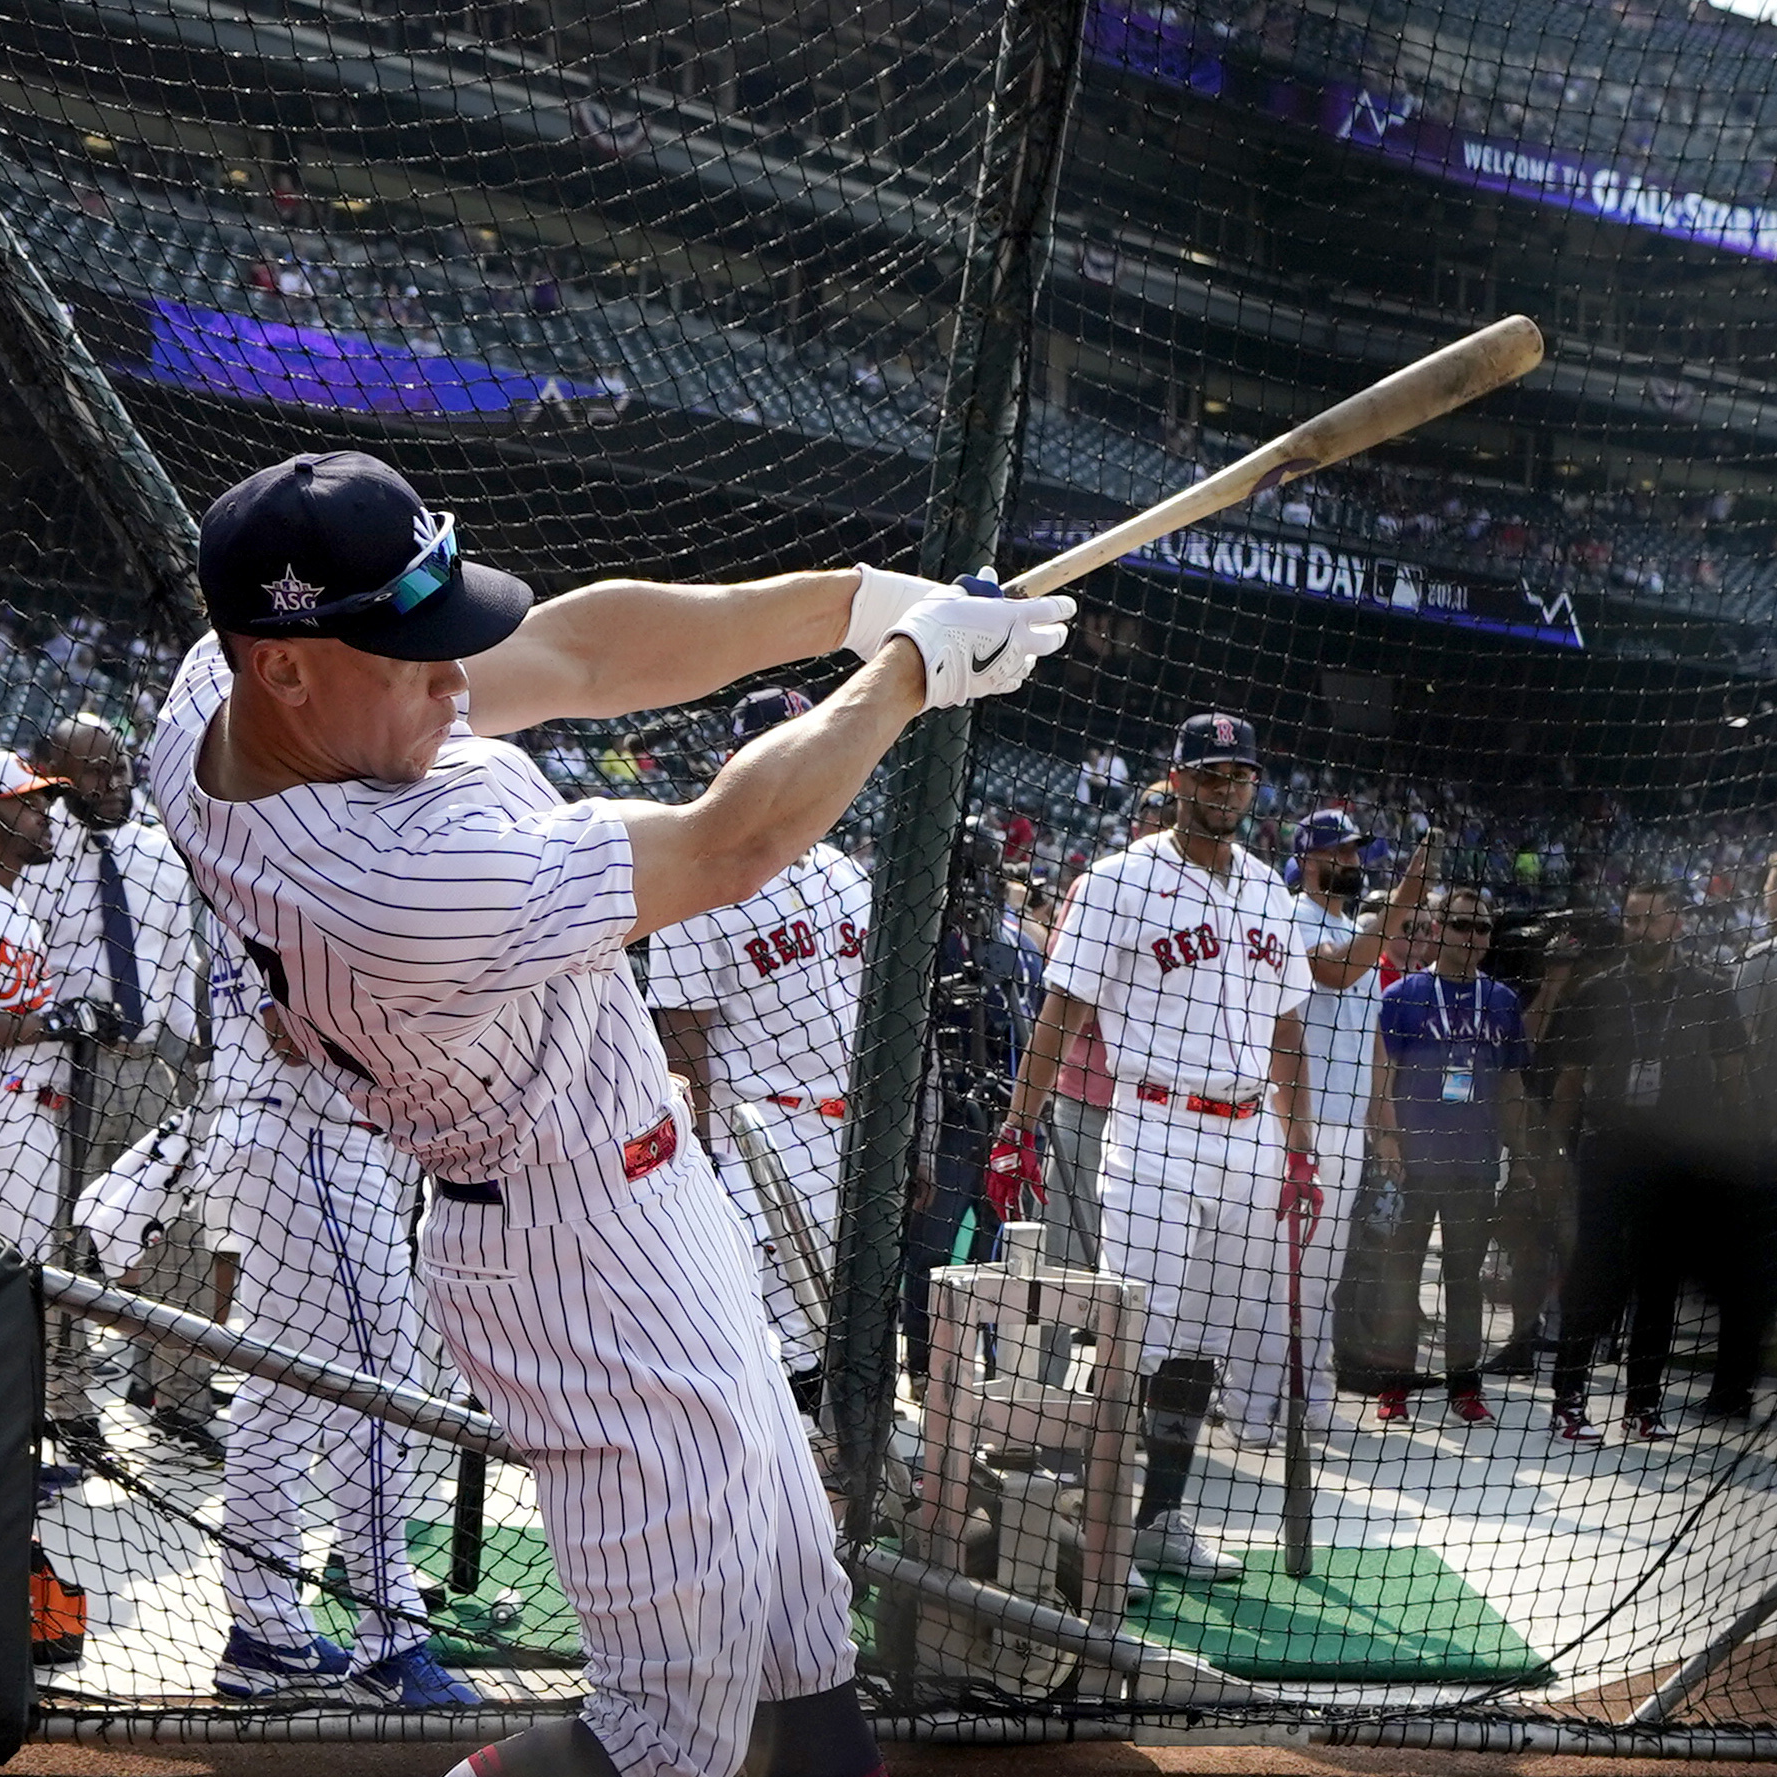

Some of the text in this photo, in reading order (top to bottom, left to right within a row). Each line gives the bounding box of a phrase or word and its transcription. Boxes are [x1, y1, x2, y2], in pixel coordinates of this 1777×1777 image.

[1464, 139, 1556, 191] WELCOME
[1307, 543, 1366, 599] DAY
[274, 591, 316, 611] ASG
[744, 920, 815, 978] RED
[1151, 922, 1220, 974] RED
